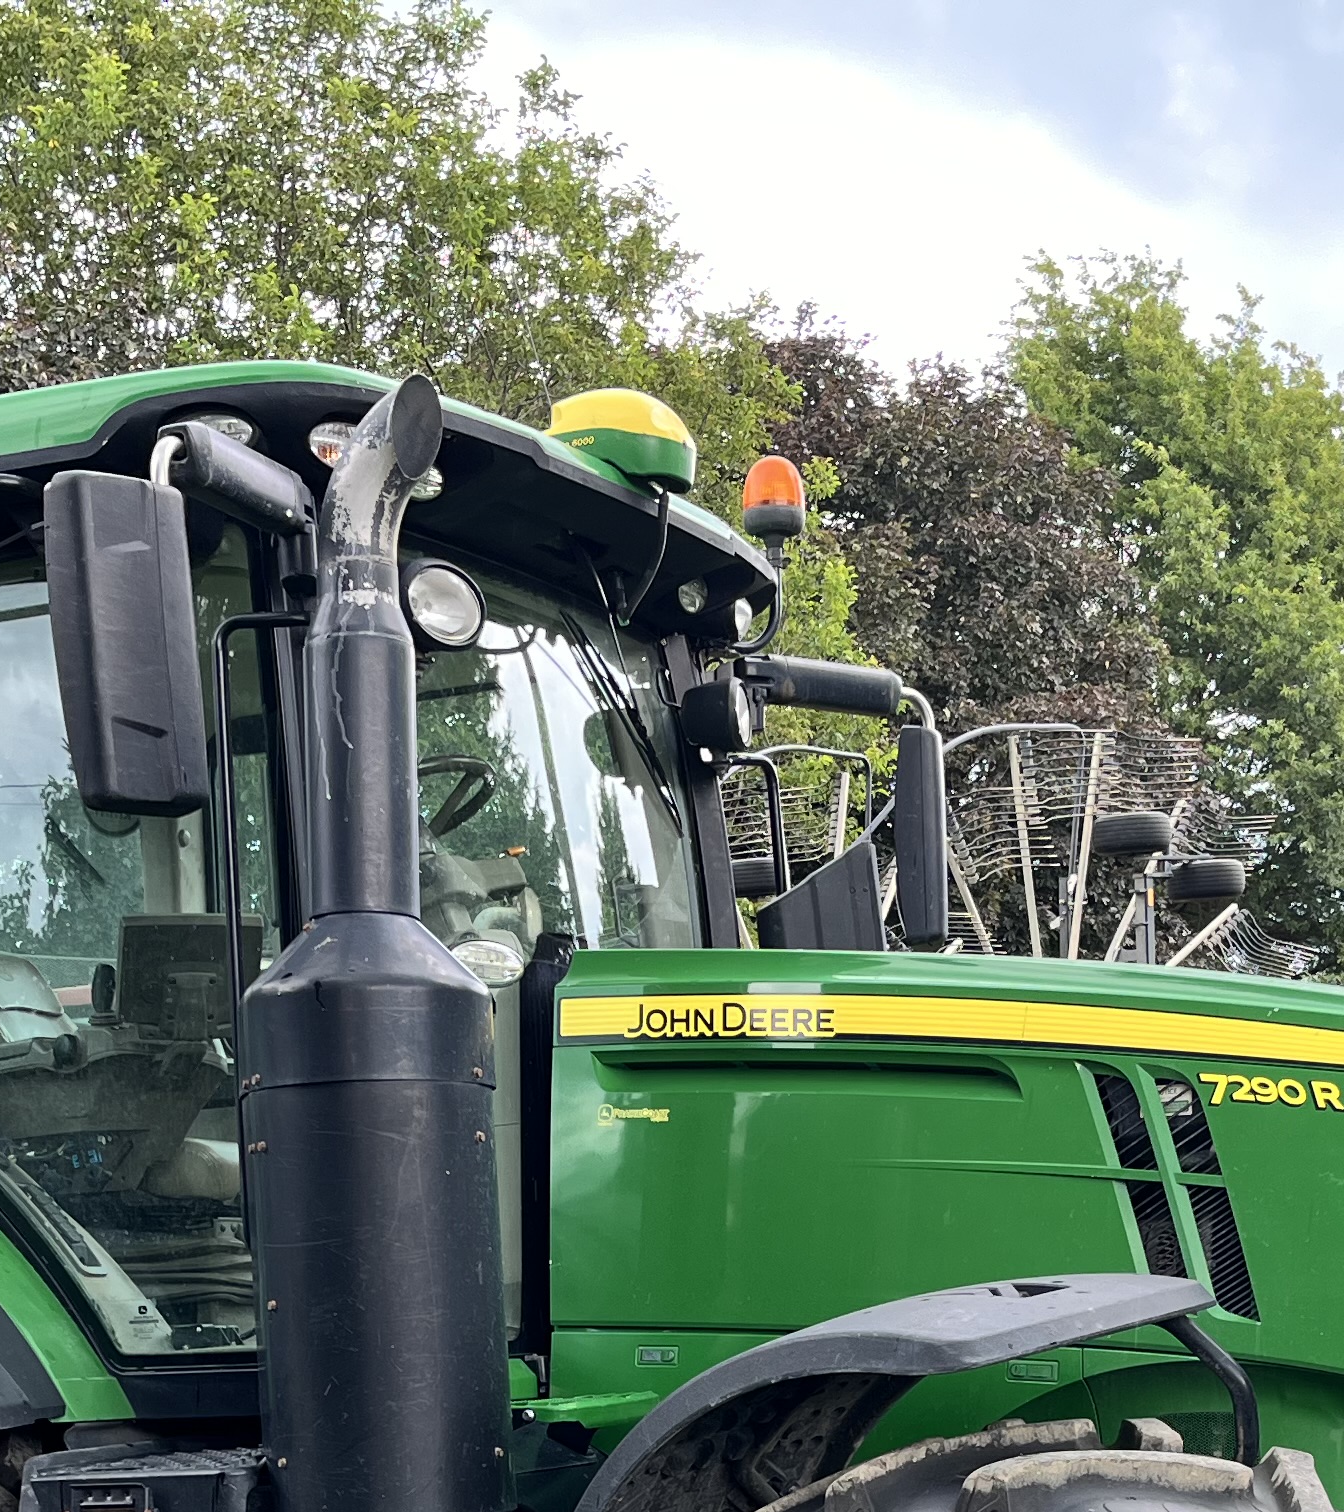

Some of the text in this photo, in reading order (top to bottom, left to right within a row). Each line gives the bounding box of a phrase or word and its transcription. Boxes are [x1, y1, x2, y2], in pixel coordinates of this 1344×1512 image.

[627, 1002, 835, 1036] JOHN DEERE
[1198, 1072, 1307, 1107] 7290
